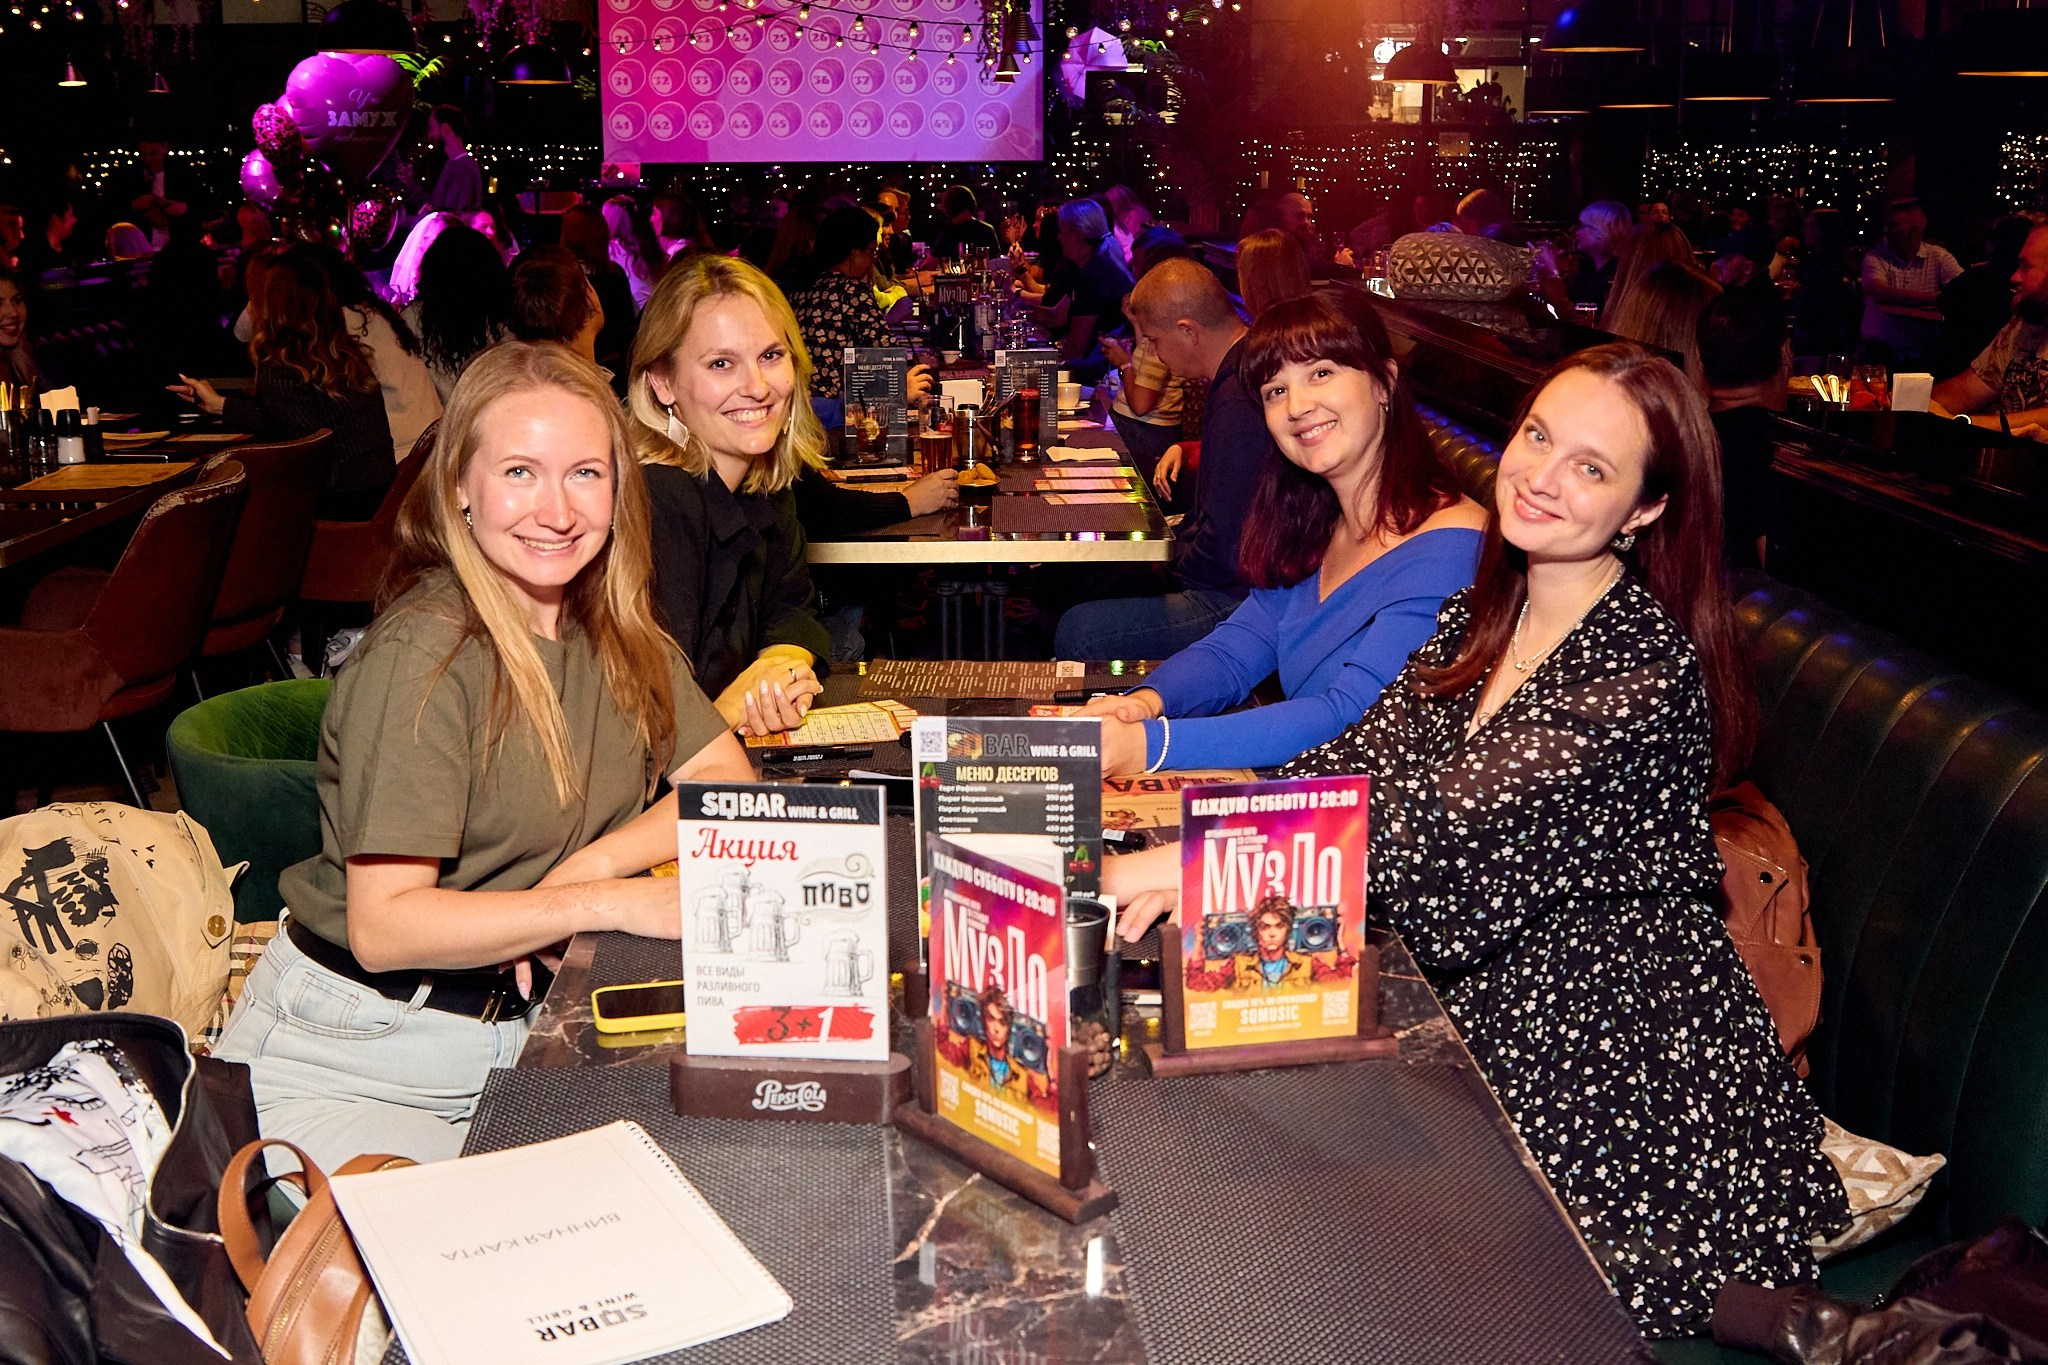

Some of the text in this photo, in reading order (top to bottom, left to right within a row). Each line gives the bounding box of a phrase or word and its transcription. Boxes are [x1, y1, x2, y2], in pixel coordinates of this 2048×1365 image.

[696, 34, 711, 43] 23
[733, 33, 749, 43] 24
[772, 33, 788, 42] 25
[811, 32, 828, 42] 26
[850, 33, 867, 42] 27
[893, 33, 909, 43] 28
[937, 33, 952, 43] 29
[614, 75, 952, 86] 31 32 33 34 35 36 37 38 39
[327, 110, 397, 127] ЗАМУЖ
[614, 119, 994, 130] 41 42 43 44 45 46 47 48 49 50
[1030, 745, 1060, 758] WINE
[1059, 745, 1068, 758] &
[1068, 745, 1098, 758] GRILL
[956, 766, 1059, 784] МЕНЮ ДЕСЕРТОВ
[700, 791, 859, 820] SQBAR WINE & GRILL
[1191, 789, 1358, 817] КАЖДУЮ СУББОТУ В 20:00
[691, 827, 799, 868] Акция
[933, 851, 974, 884] КАЖДУЮ
[973, 866, 1016, 901] СУББОТУ
[1016, 884, 1024, 903] В
[1024, 888, 1056, 917] 20:00
[696, 966, 745, 978] ВСЕ ВИДЫ
[697, 981, 760, 993] РАЗЛИВНОГО
[697, 996, 724, 1006] ПИВА
[439, 1212, 621, 1262] ВИННАЯ КАРТА
[597, 1292, 638, 1307] WINE
[527, 1309, 573, 1325] GRILL
[534, 1303, 648, 1342] SQBAR
